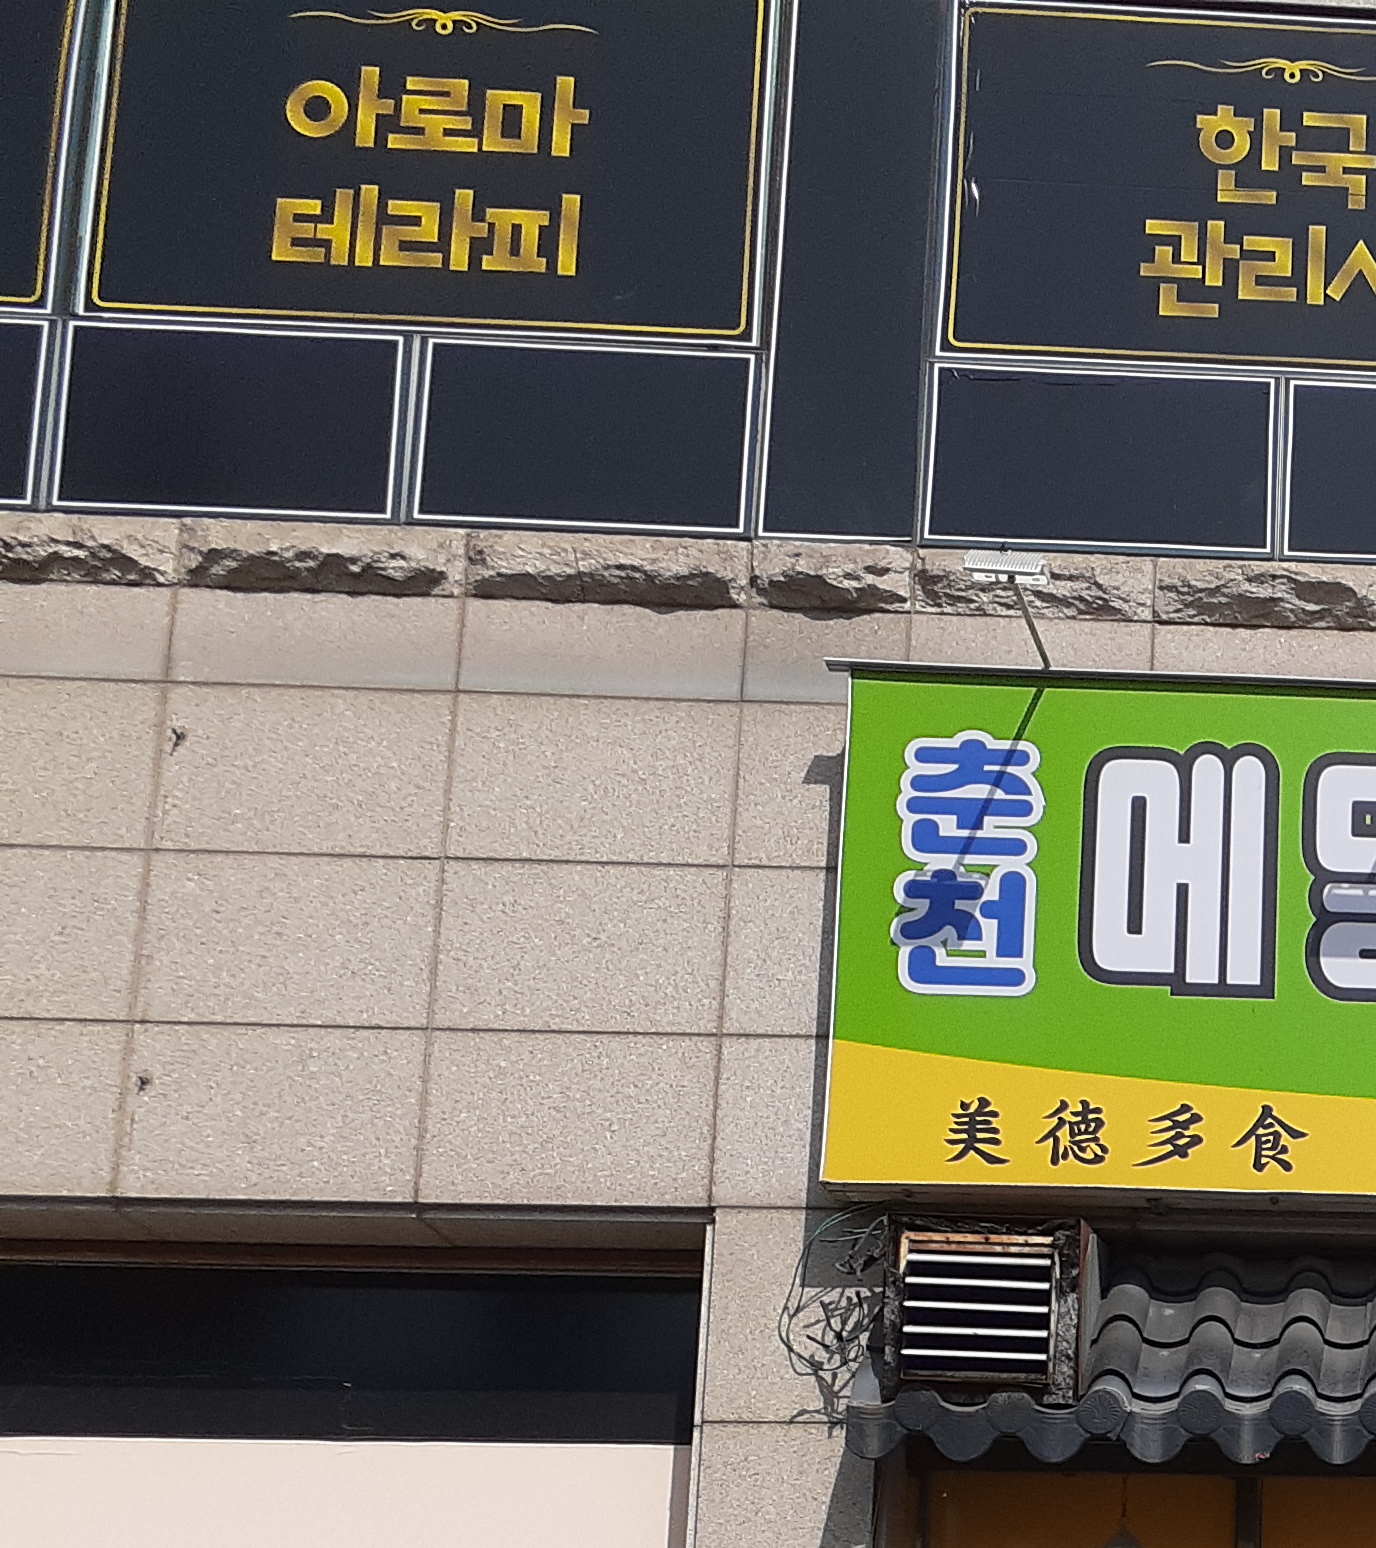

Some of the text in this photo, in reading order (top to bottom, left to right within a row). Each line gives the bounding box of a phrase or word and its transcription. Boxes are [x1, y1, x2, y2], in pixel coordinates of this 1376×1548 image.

[285, 65, 590, 157] 아로마
[270, 184, 582, 277] 테라피
[892, 729, 1044, 997] 춘천
[943, 1095, 1308, 1173] 美德多食
